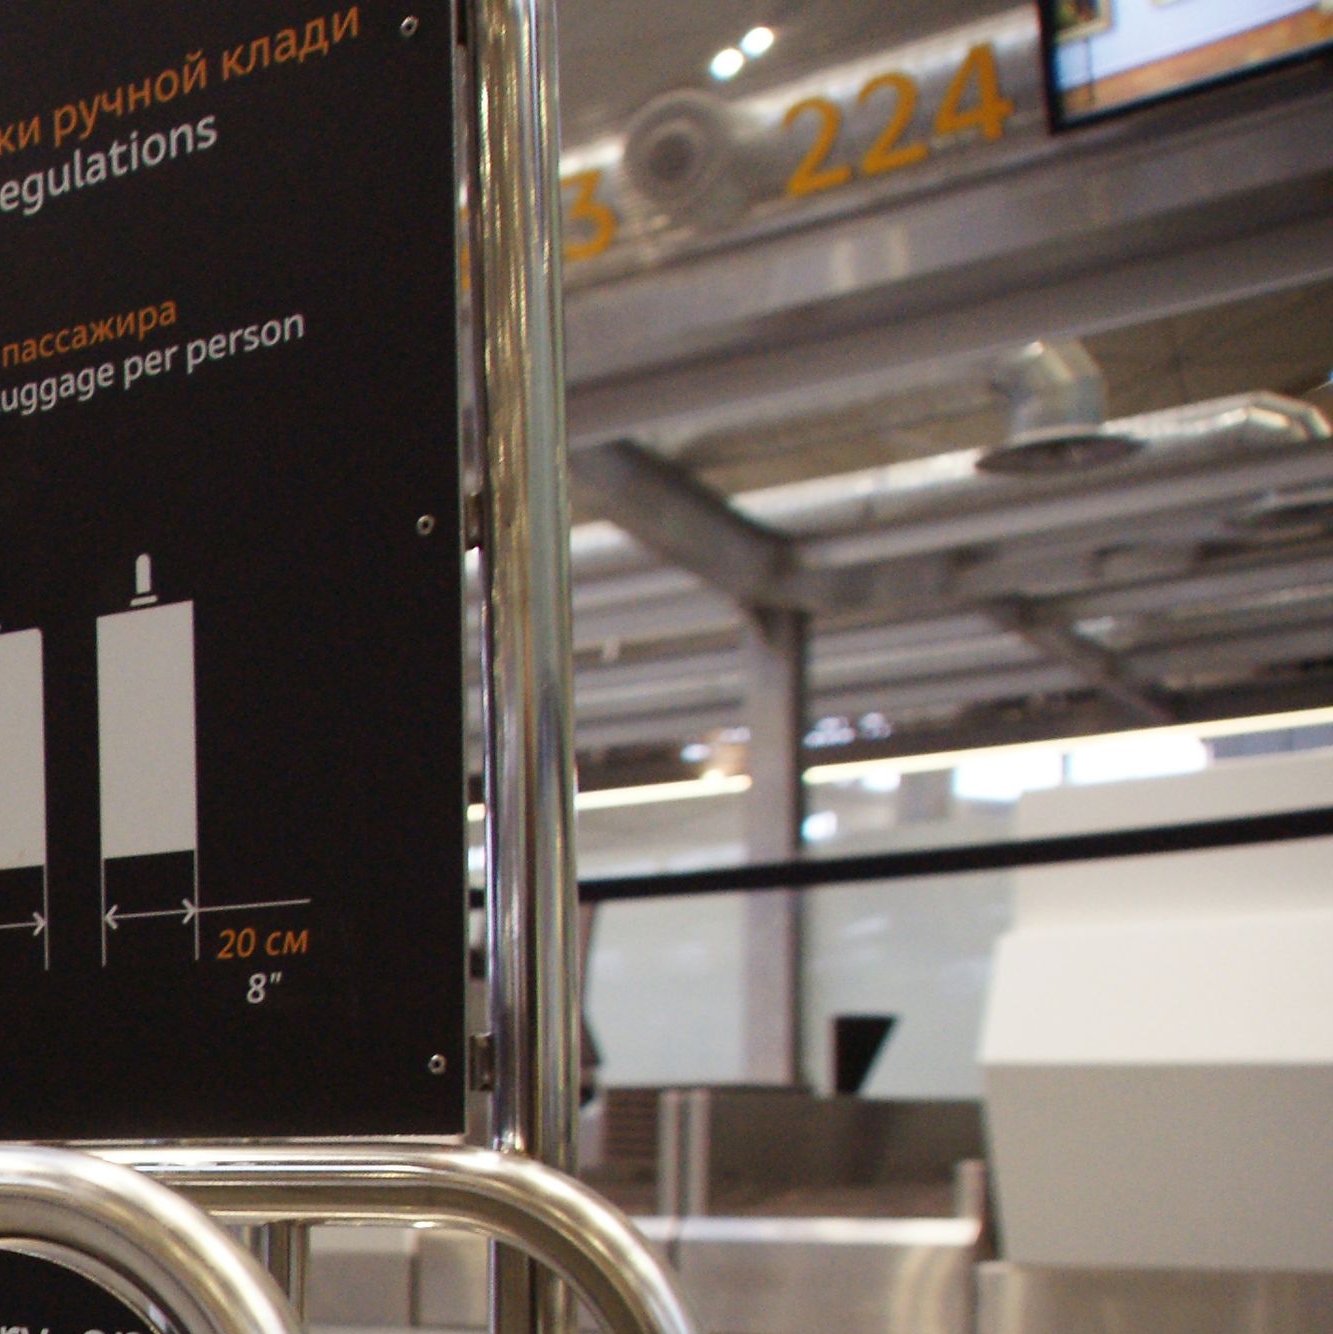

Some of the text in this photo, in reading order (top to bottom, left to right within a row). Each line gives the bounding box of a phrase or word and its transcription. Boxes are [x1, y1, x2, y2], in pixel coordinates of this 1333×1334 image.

[54, 50, 207, 148] ручной
[222, 6, 358, 81] клади
[782, 43, 1014, 199] 224
[3, 300, 176, 367] пассажира
[124, 345, 179, 390] per
[187, 313, 304, 374] person
[217, 927, 309, 960] 20 см
[246, 971, 282, 1004] 8"
